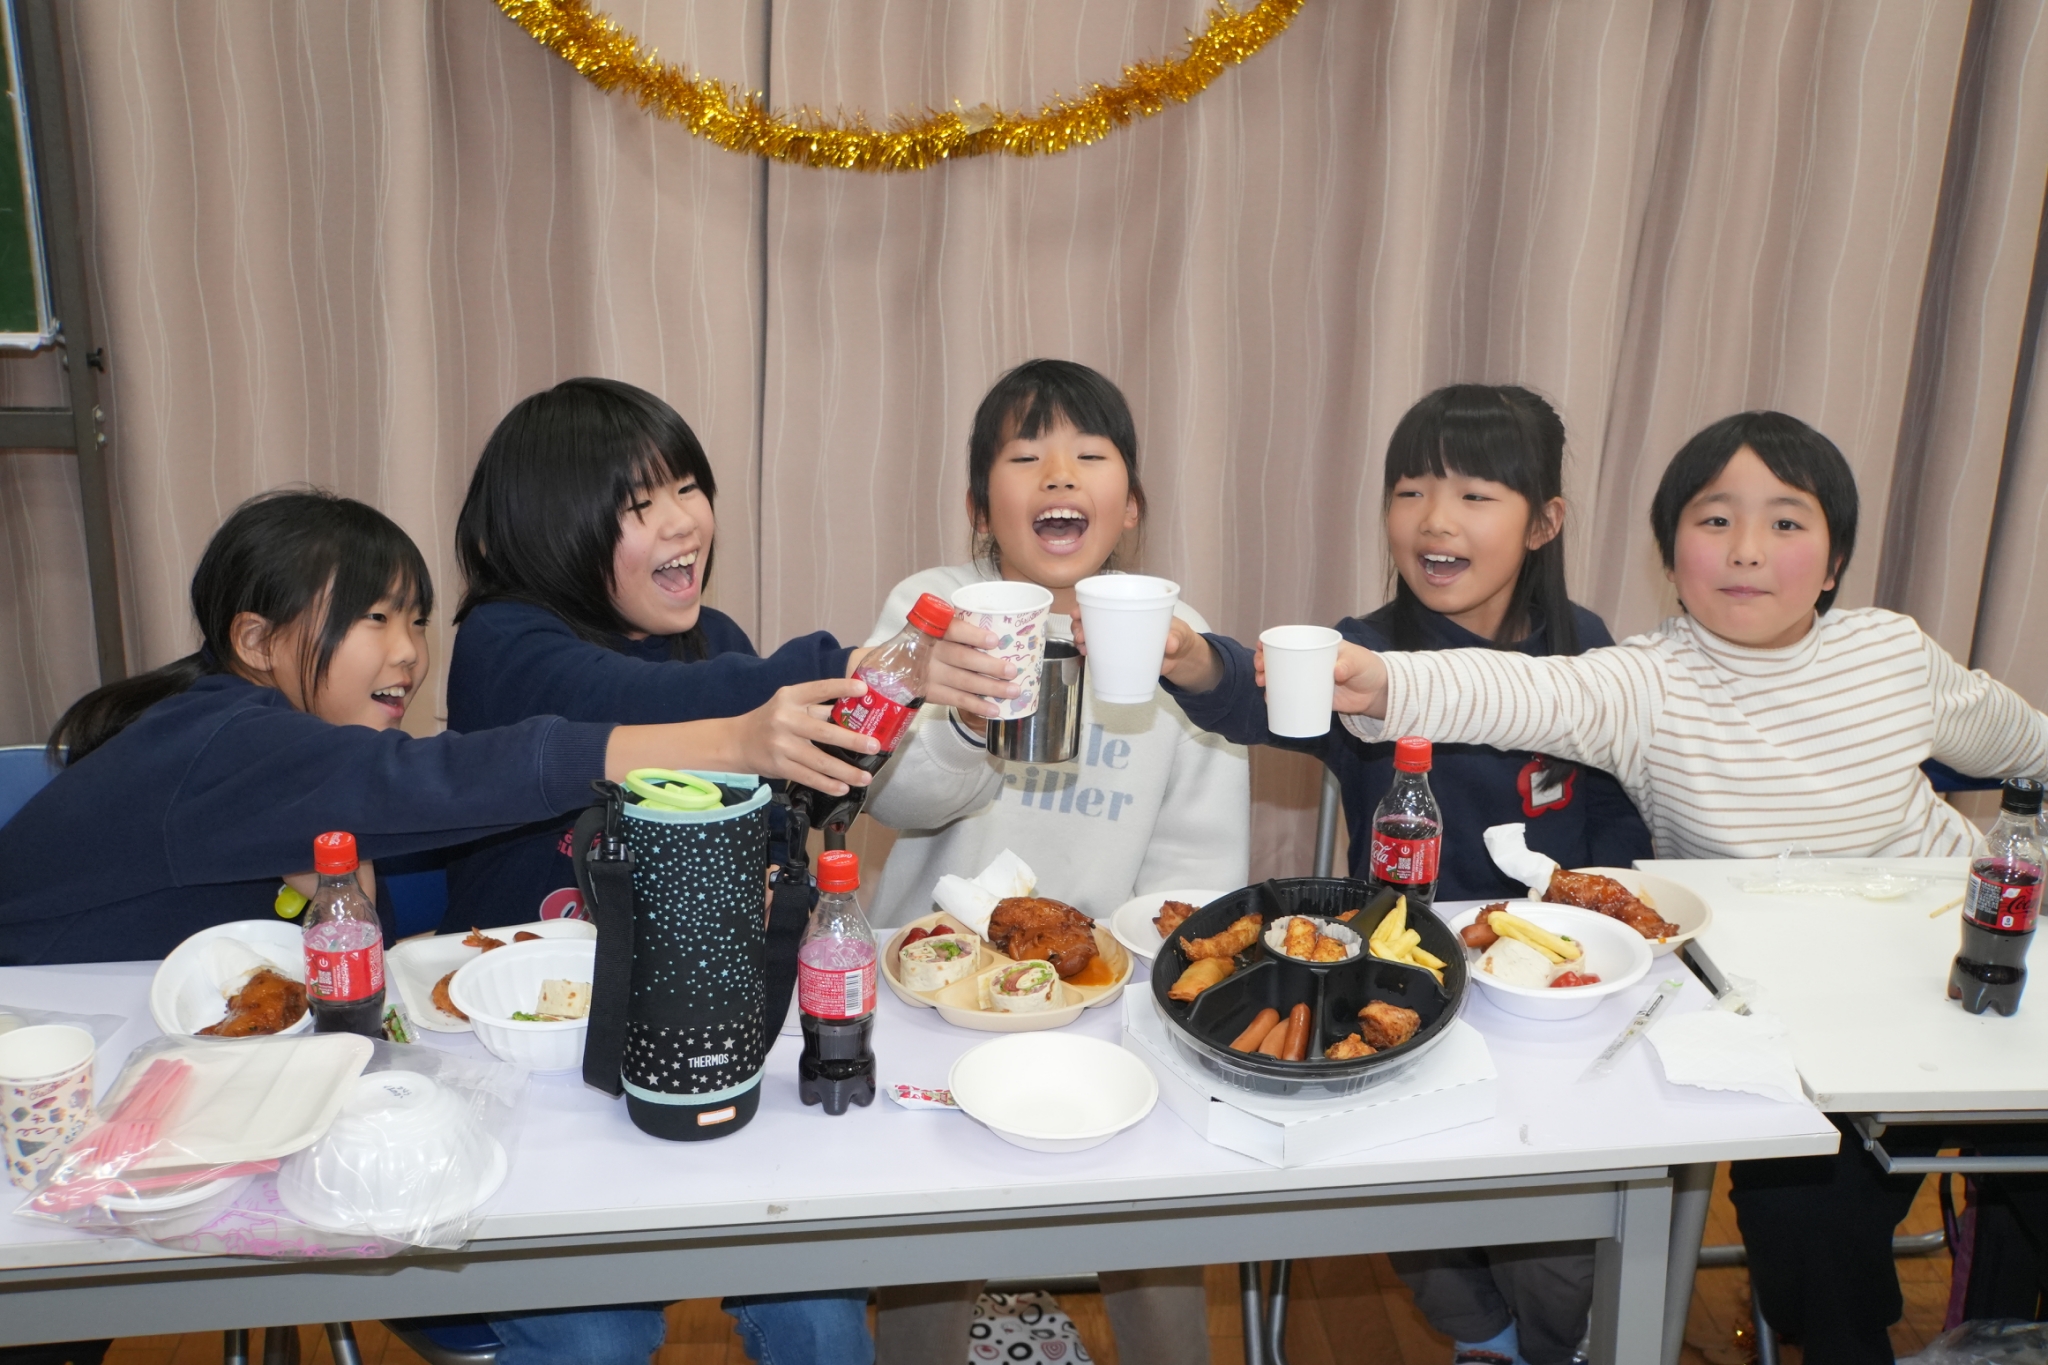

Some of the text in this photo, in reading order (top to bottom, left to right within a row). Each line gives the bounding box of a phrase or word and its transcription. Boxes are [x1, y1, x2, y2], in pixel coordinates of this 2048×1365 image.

[1068, 722, 1132, 770] le
[993, 765, 1135, 822] riller
[687, 1053, 730, 1069] THERMOS
